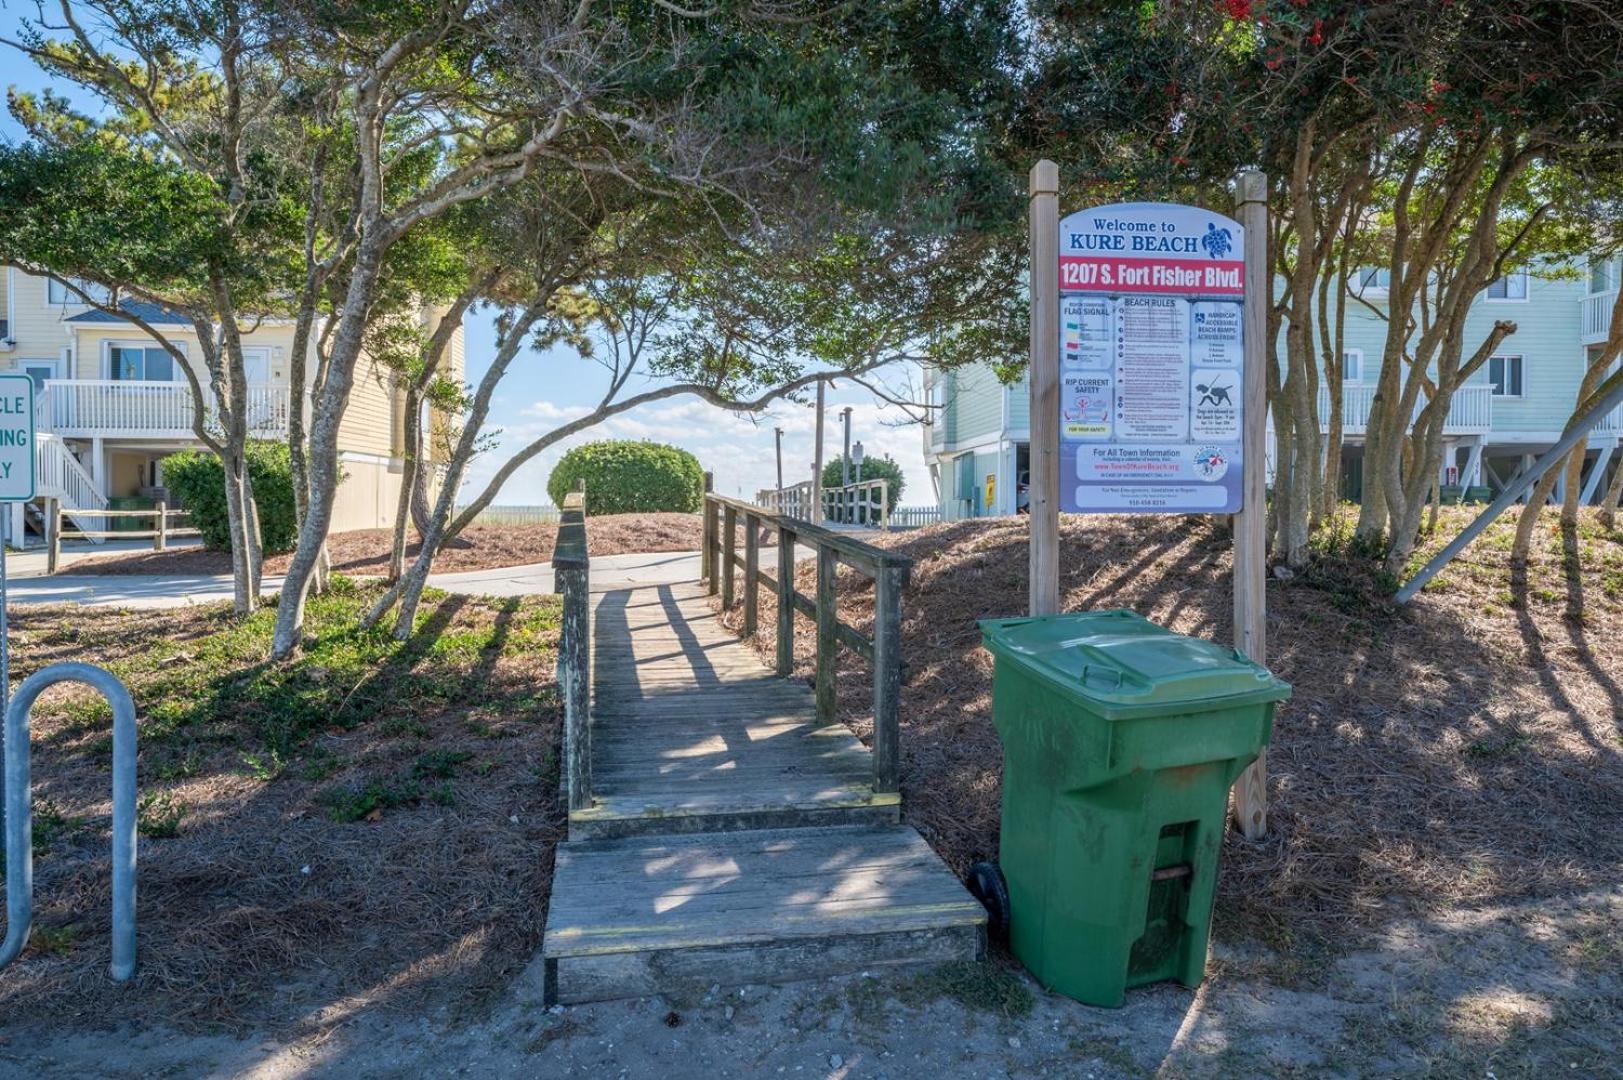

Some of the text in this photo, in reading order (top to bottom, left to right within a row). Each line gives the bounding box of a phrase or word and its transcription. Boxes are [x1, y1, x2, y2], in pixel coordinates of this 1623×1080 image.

[1093, 218, 1176, 232] Welcome to
[1070, 234, 1198, 252] KURE BEACH
[1062, 263, 1242, 288] 1207 S. Fort Fisher Blvd.
[1125, 298, 1176, 307] BEACH RULES
[1064, 308, 1082, 316] FLAG
[1083, 308, 1109, 316] SIGNAL
